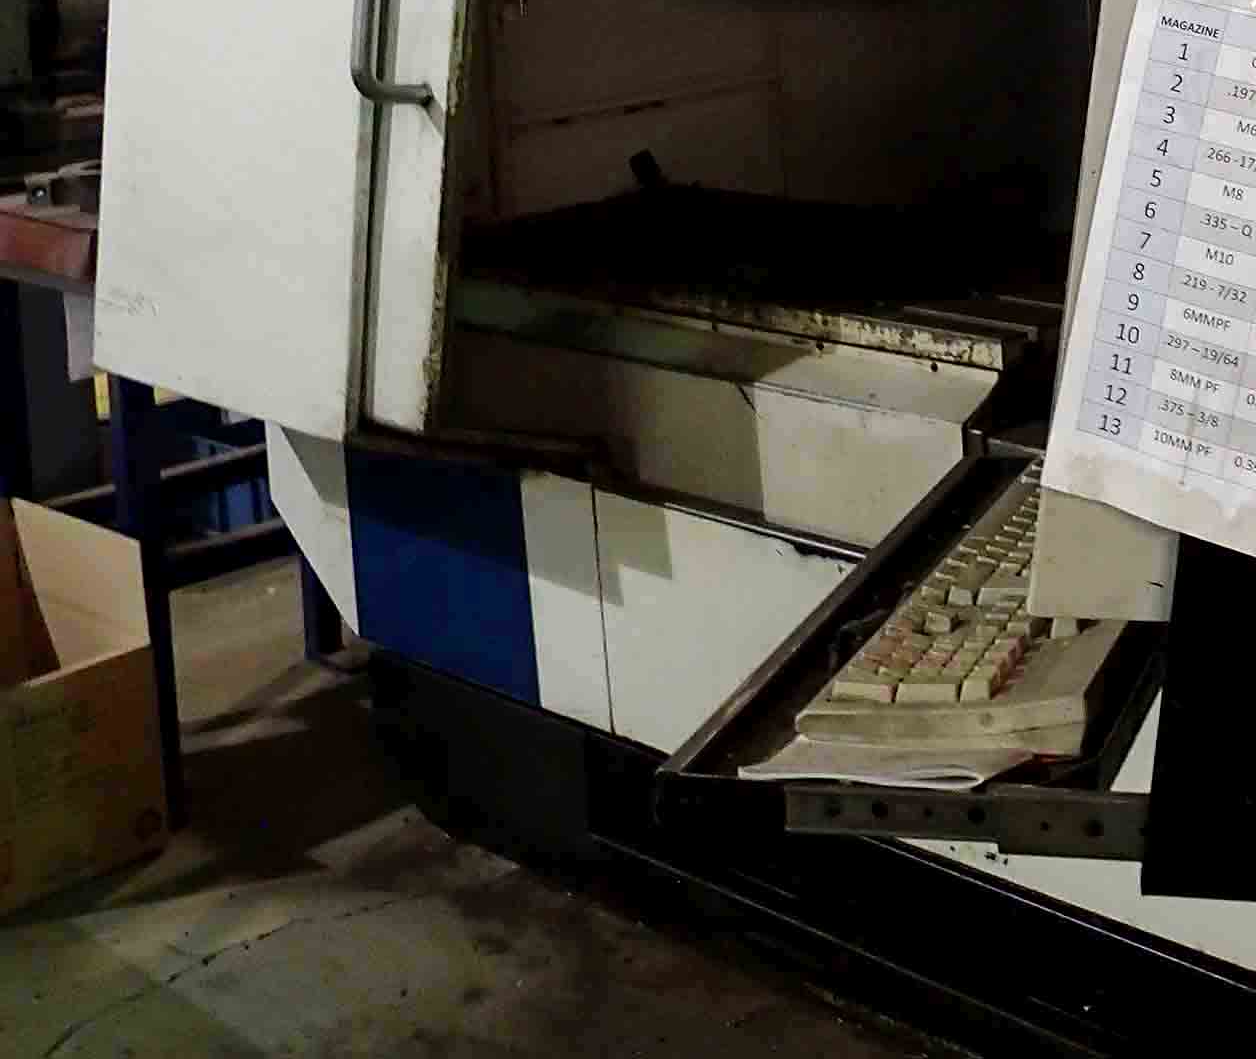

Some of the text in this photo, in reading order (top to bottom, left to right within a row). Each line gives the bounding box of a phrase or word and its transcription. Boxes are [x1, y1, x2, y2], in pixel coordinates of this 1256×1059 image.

[1160, 16, 1221, 39] MAGAZINE
[1178, 43, 1190, 61] 1
[1170, 74, 1184, 93] 2
[1163, 106, 1177, 124] 3
[1156, 139, 1170, 157] 4
[1150, 169, 1162, 188] 5
[1221, 185, 1244, 201] M8
[1144, 201, 1157, 220] 6
[1139, 231, 1152, 250] 7
[1205, 248, 1235, 266] M10
[1132, 262, 1145, 281] 8
[1127, 293, 1140, 311] 9
[1115, 323, 1140, 344] 10
[1110, 353, 1133, 375] 11
[1104, 384, 1128, 406] 12
[1098, 414, 1122, 436] 13
